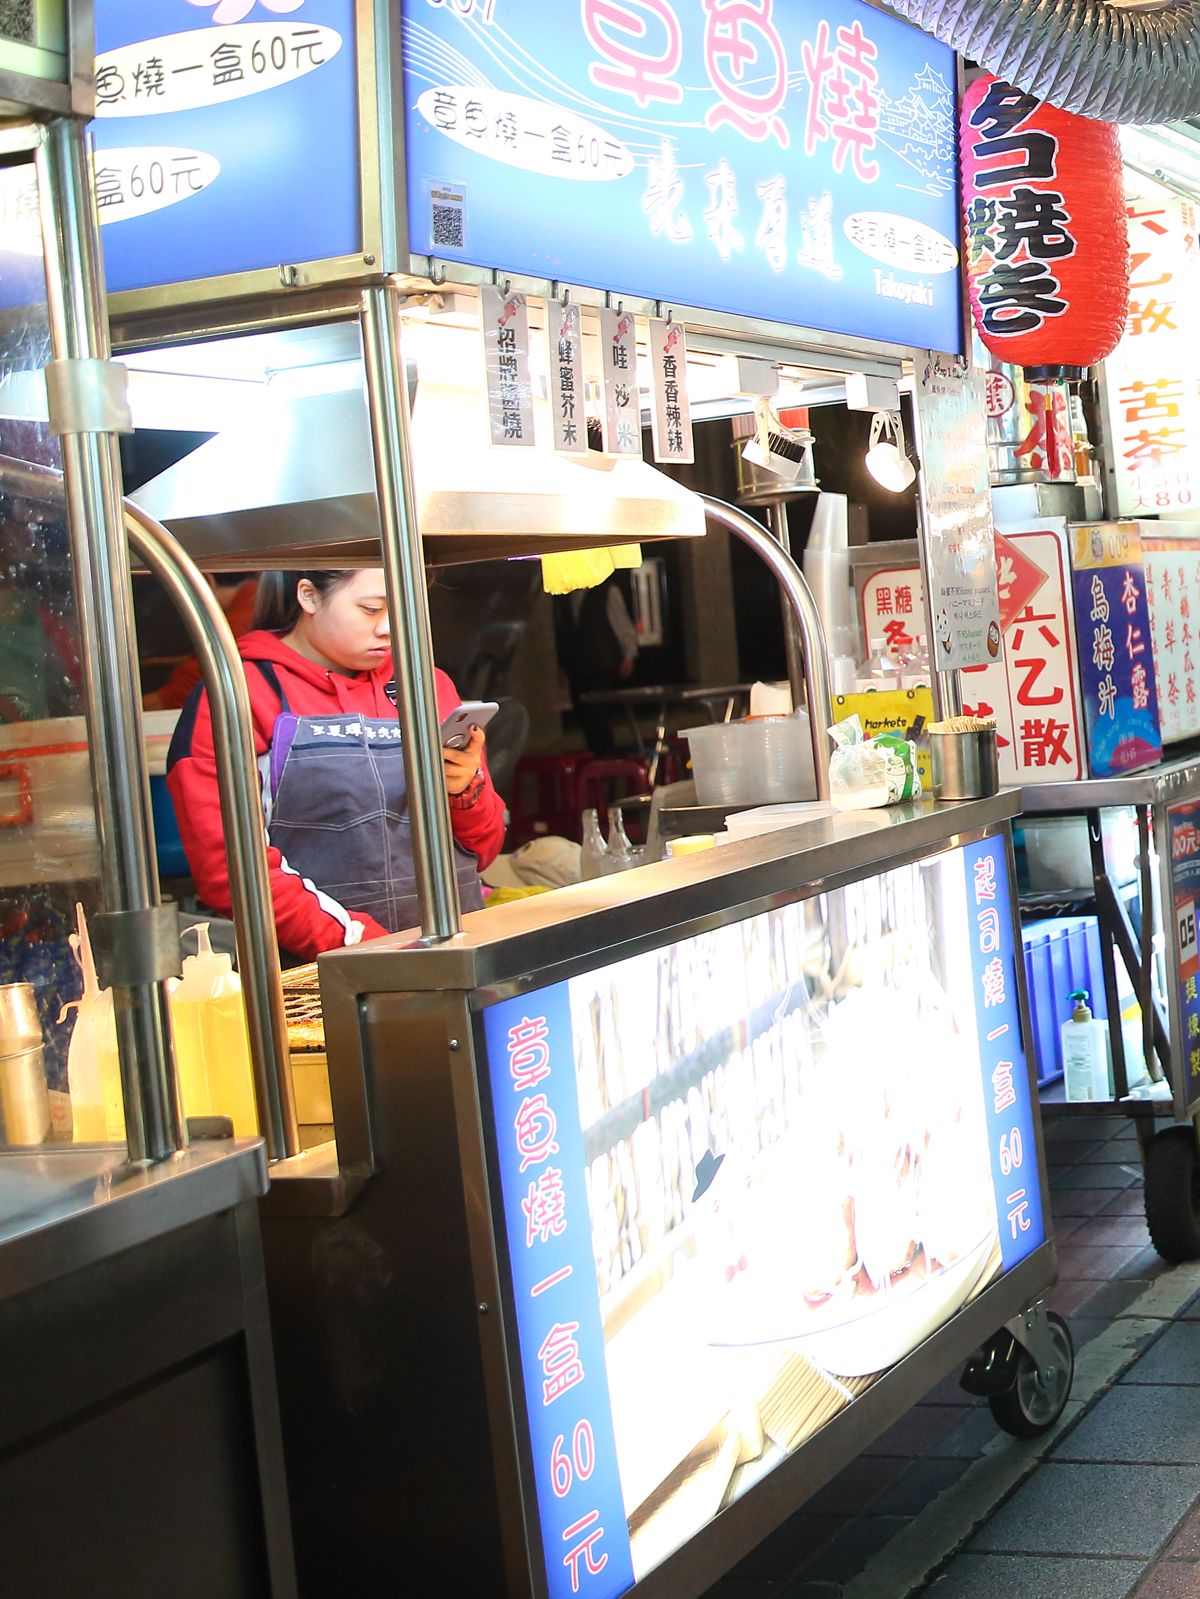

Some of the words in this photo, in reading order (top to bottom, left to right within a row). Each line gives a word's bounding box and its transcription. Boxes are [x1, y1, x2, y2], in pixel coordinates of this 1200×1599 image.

[433, 91, 623, 177] 章魚燒一盒60元
[968, 81, 1076, 335] タコ焼き
[873, 267, 934, 308] Takoyaki
[557, 338, 578, 446] 蜂蜜芥末
[611, 344, 634, 447] 哇沙米
[662, 354, 684, 453] 香香辣辣
[1011, 605, 1074, 767] 六乙散
[1120, 570, 1150, 710] 杏仁露
[1160, 568, 1180, 707] 青草茶
[864, 716, 908, 730] Markets
[974, 855, 1031, 1241] 起司燒一盒60元
[506, 1015, 610, 1594] 章魚燒一盒60元
